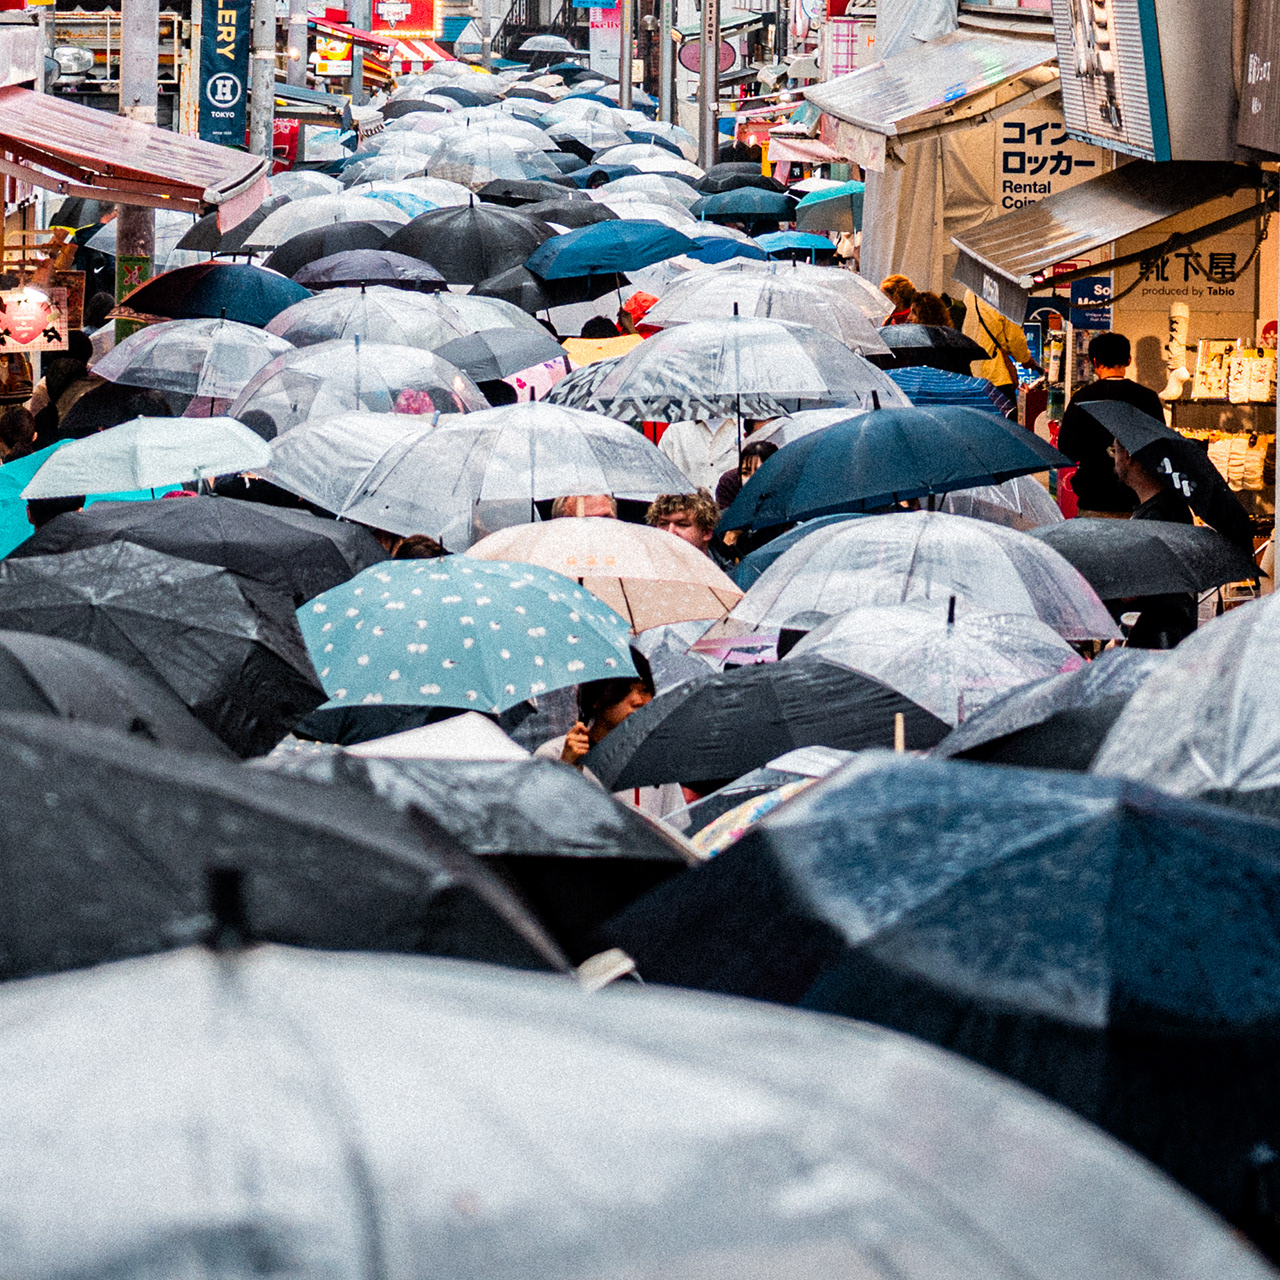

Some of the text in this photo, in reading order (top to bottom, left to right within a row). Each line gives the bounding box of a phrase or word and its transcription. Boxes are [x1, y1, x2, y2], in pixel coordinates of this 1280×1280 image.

[1003, 122, 1070, 145] コイン
[1003, 151, 1095, 175] ロッカー
[1002, 180, 1051, 194] Rental
[1139, 252, 1237, 282] 靴下屋
[1142, 286, 1235, 297] produced by Tabio
